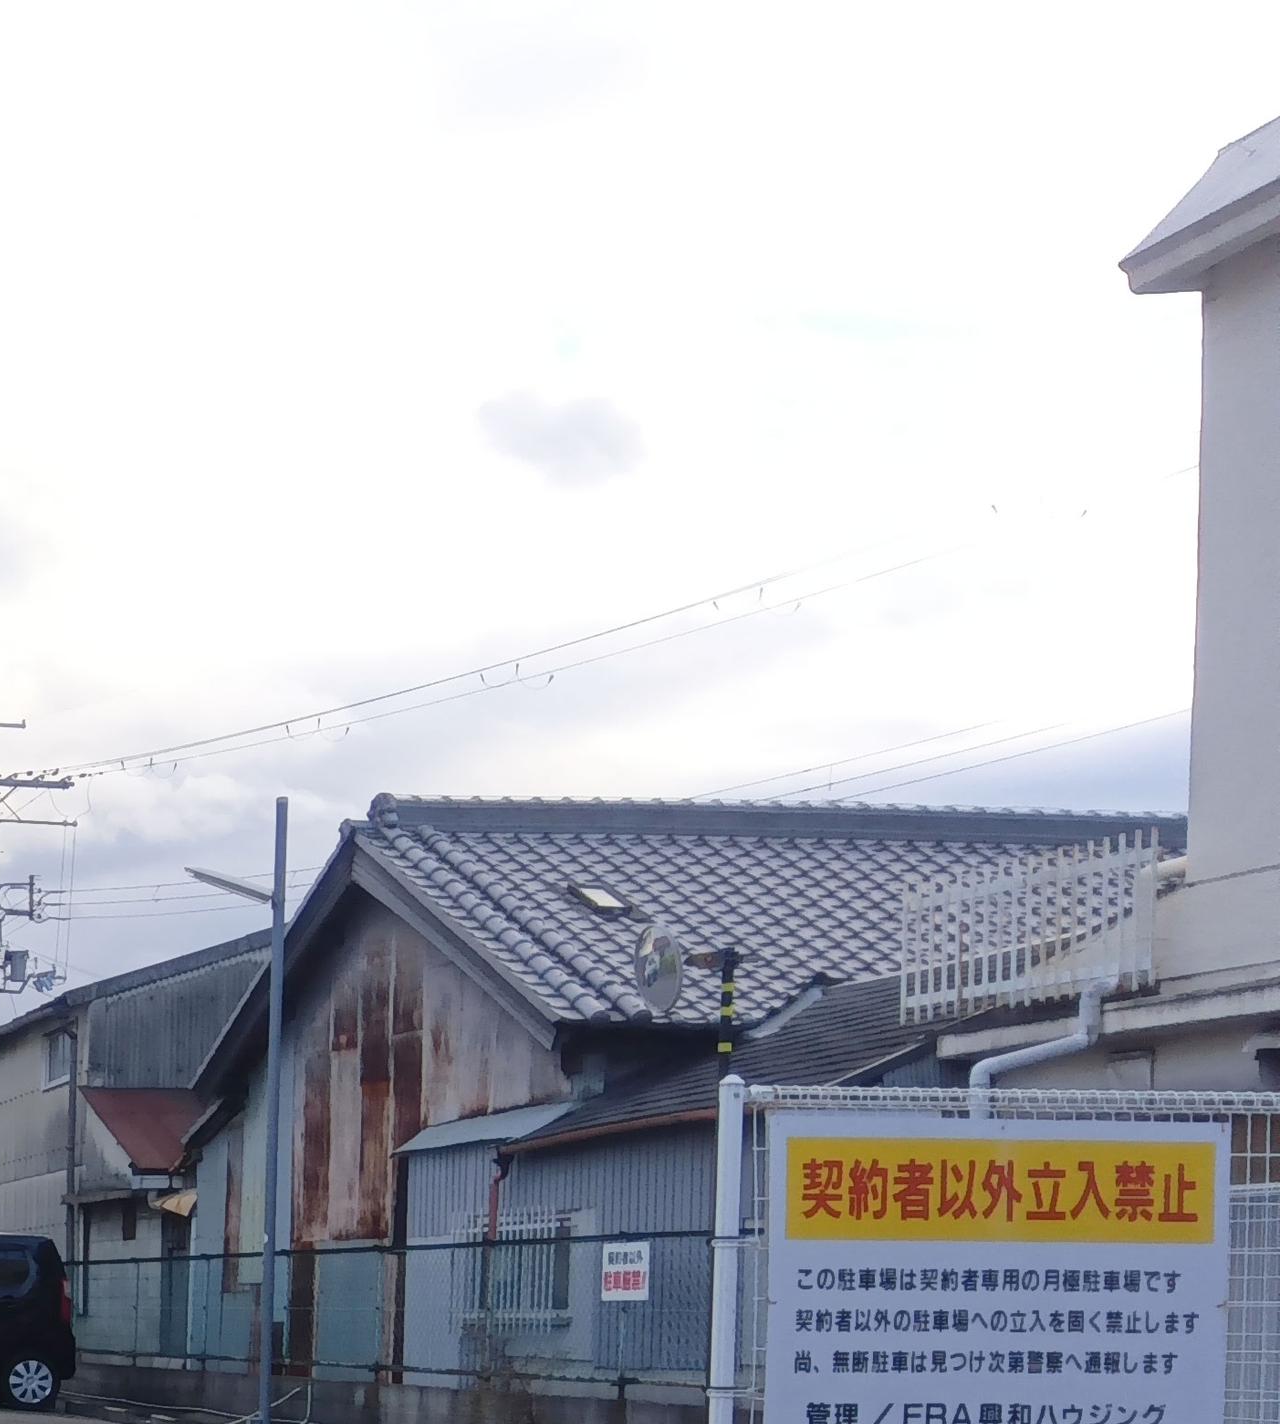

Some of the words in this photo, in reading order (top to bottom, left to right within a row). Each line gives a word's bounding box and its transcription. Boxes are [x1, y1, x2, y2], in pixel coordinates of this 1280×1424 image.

[801, 1158, 1198, 1222] 契約者以外立入禁止
[797, 1267, 1182, 1294] この駐車場は契約者専用の月極駐車場です
[795, 1309, 1200, 1334] 契約者以外の駐車場への立入を固く禁止します
[793, 1350, 1179, 1375] 尚、無断駐車は見つけ次第警察へ通報します
